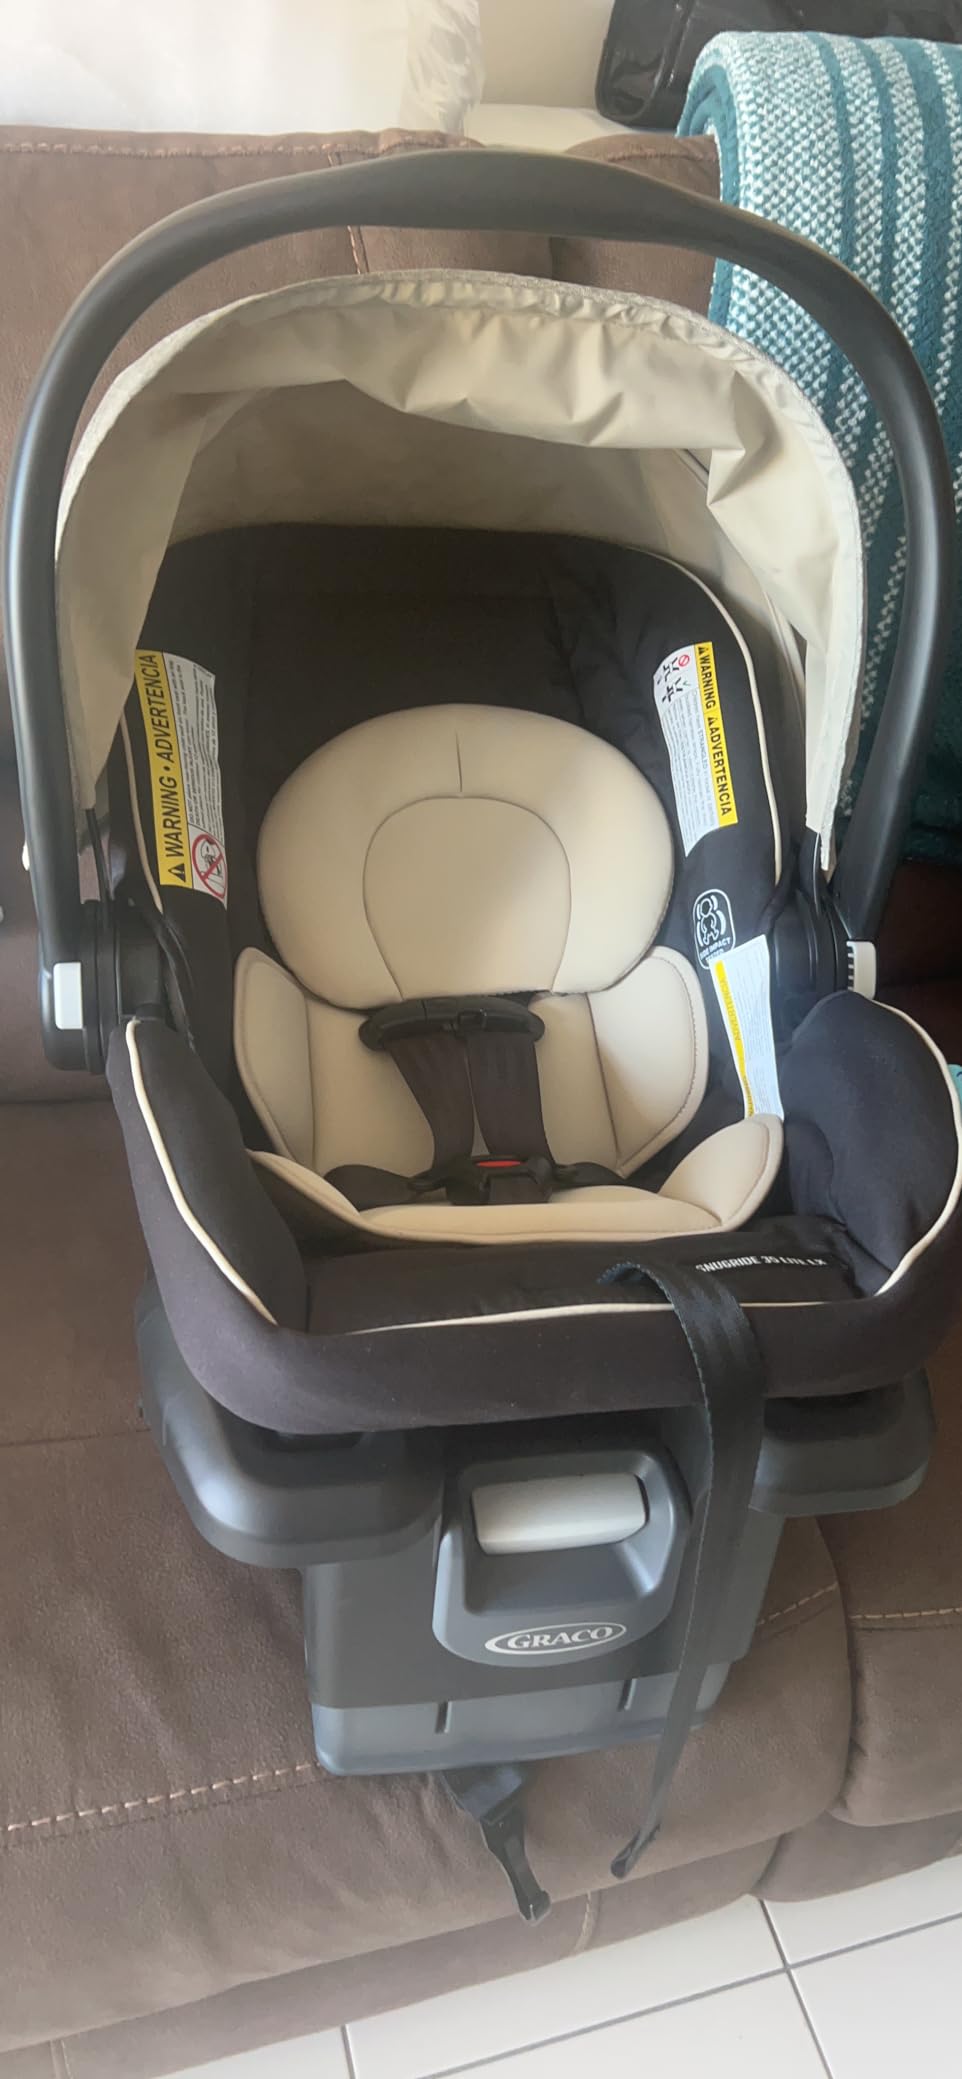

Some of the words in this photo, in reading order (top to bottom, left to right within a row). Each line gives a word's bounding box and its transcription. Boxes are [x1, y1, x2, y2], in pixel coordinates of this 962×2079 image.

[138, 653, 175, 763] ADVERTENCIA
[698, 656, 717, 709] WARNING
[709, 727, 732, 816] ADVERTENCIA
[159, 776, 185, 858] WARNING
[709, 936, 731, 953] IMPACT
[695, 1255, 761, 1273] SNUGRIDE
[807, 1258, 827, 1266] LX
[507, 1626, 613, 1649] GRACO
